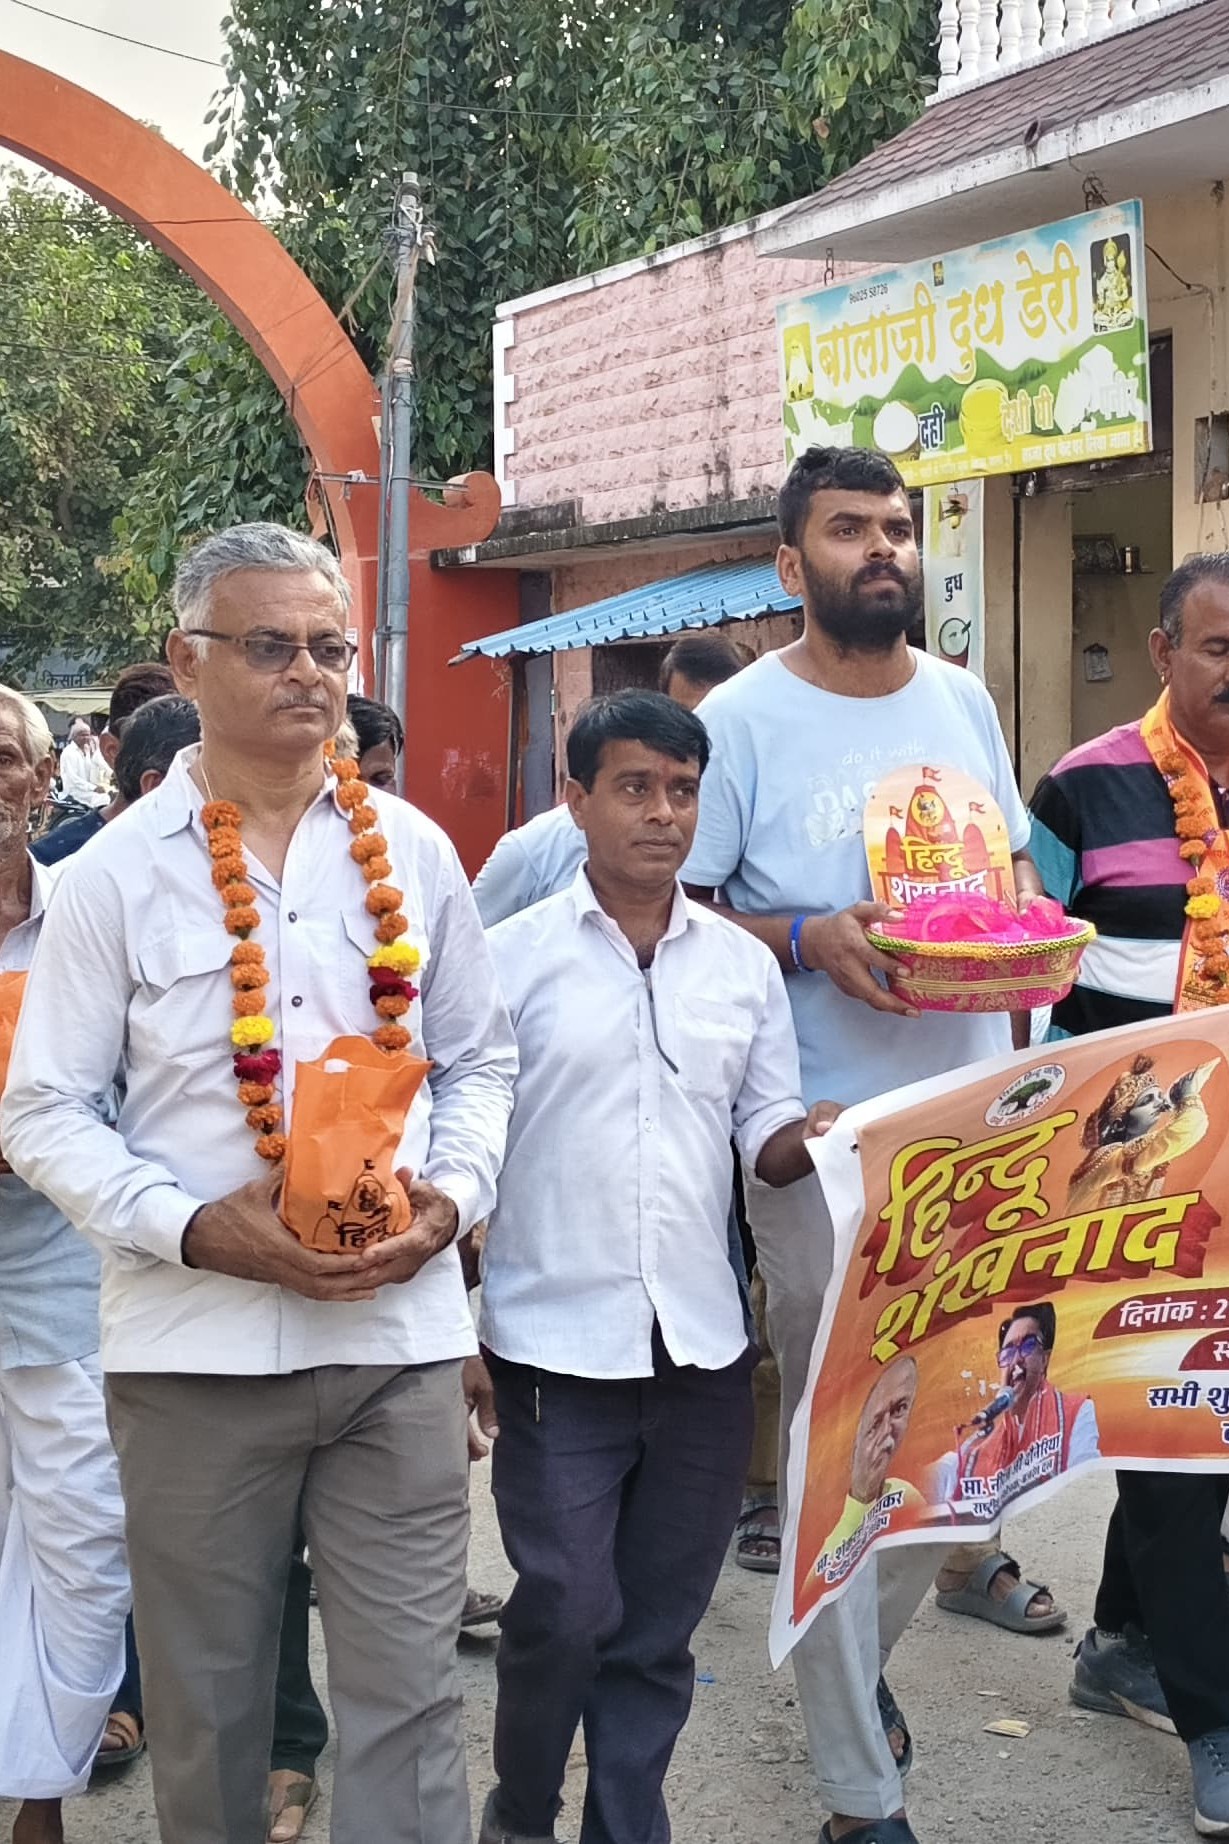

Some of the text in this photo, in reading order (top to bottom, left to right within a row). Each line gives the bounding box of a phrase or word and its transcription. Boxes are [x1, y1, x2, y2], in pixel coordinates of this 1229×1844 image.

[816, 281, 937, 387] बालाजी
[1016, 241, 1080, 337] डेरी
[918, 403, 946, 450] दही
[899, 834, 971, 879] हिन्दू
[875, 1110, 1079, 1274] हिन्दू
[870, 1190, 1203, 1365] शंखनाद
[1119, 1297, 1198, 1328] दिनांक
[1148, 1380, 1201, 1408] सभी
